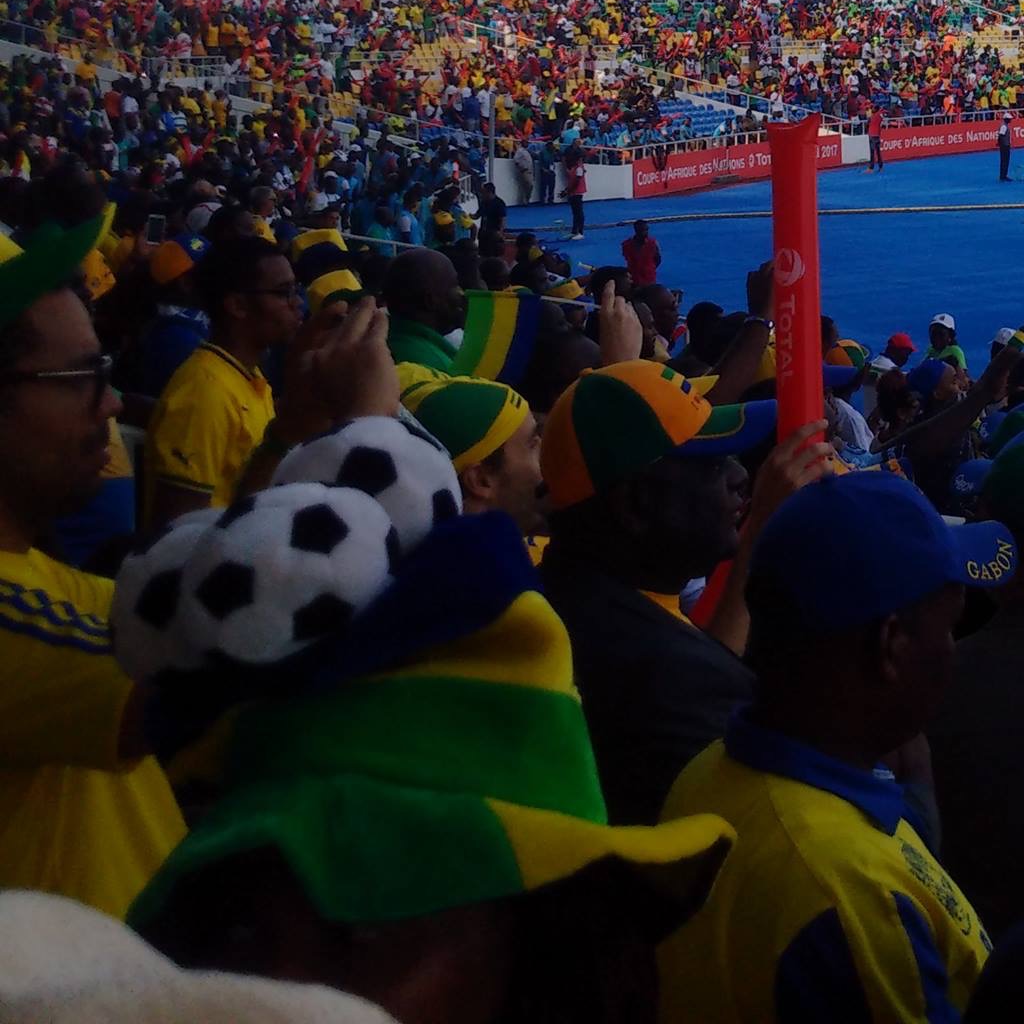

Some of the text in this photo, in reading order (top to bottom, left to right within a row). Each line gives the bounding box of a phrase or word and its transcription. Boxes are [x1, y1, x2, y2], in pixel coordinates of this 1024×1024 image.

[905, 135, 945, 149] D'AFRIQUE
[948, 134, 963, 144] DES
[821, 144, 838, 158] 2017
[699, 161, 713, 175] DES
[967, 536, 1014, 581] GABON
